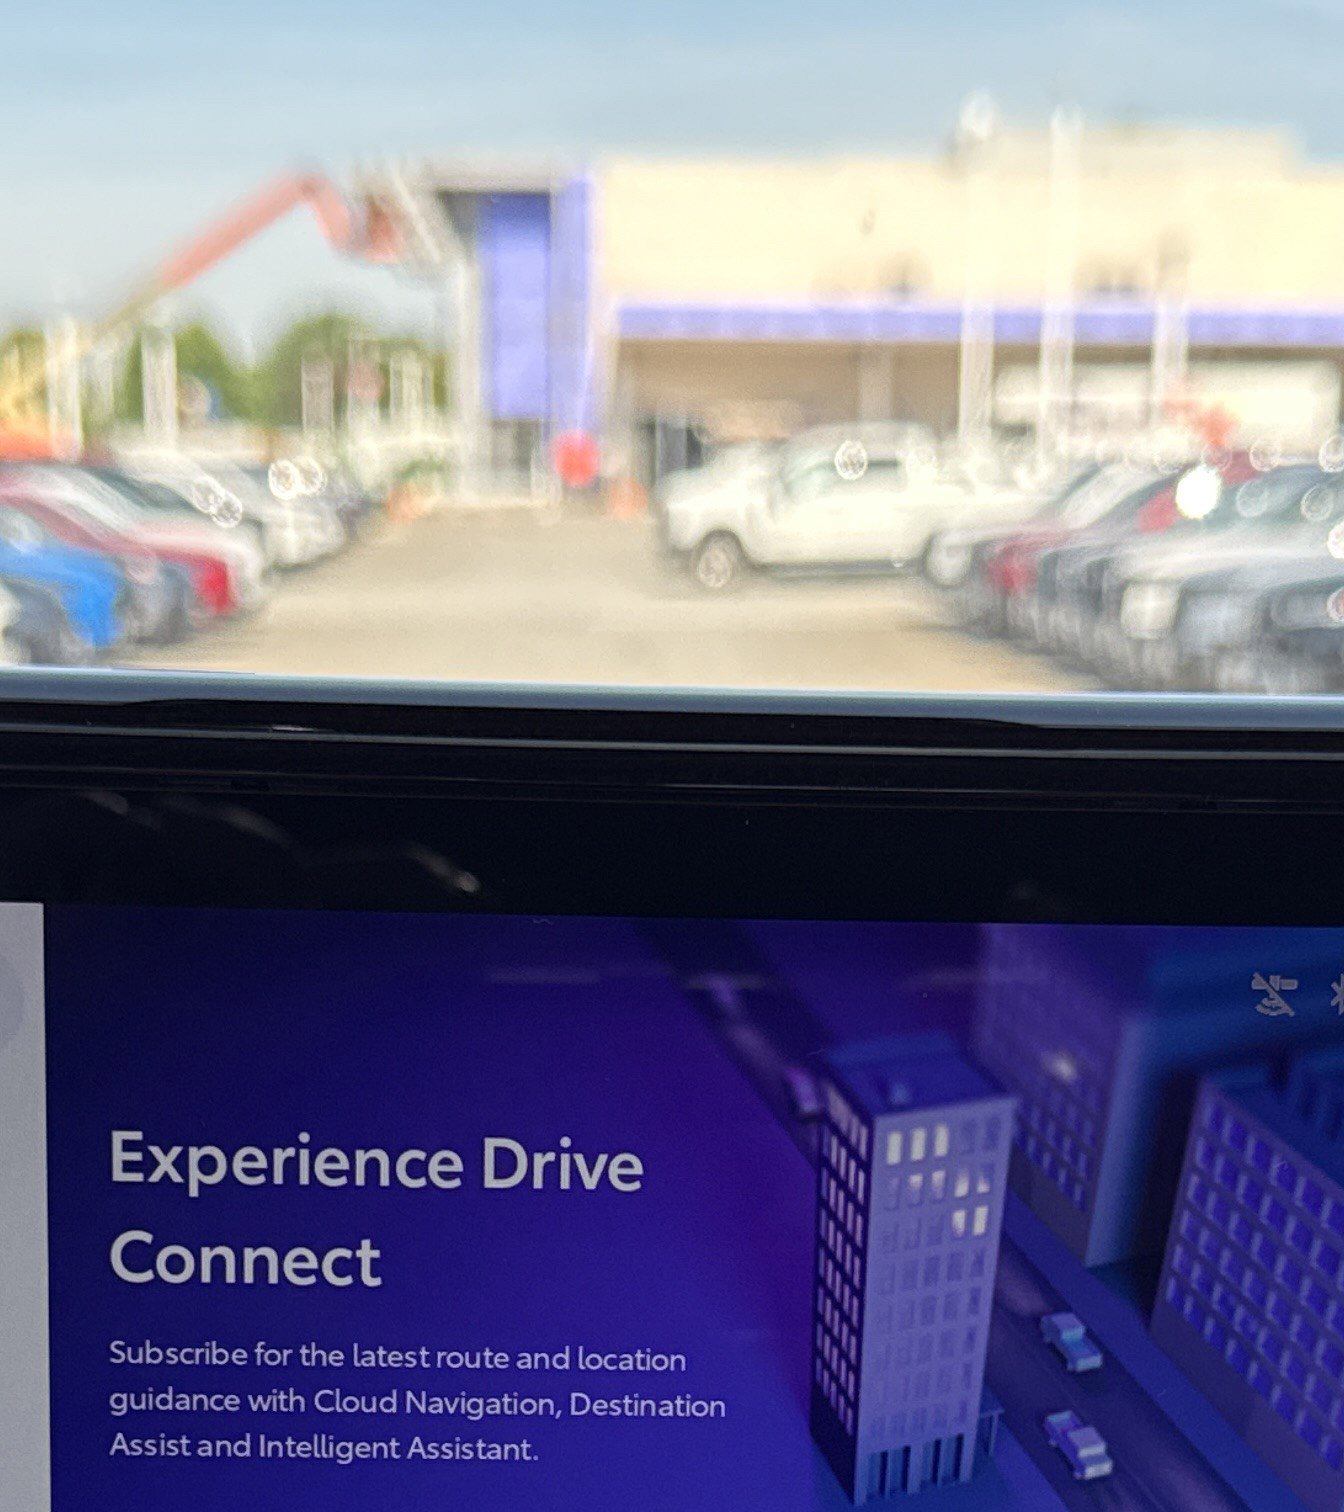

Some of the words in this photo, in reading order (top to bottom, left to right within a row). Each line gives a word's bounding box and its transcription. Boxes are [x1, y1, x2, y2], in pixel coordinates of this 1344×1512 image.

[111, 1130, 464, 1198] Experience
[483, 1136, 644, 1192] Drive
[110, 1229, 382, 1287] Connect
[109, 1339, 248, 1366] Subscribe
[254, 1341, 294, 1366] for
[299, 1341, 345, 1367] the
[353, 1342, 431, 1368] latest
[436, 1347, 510, 1369] route
[516, 1345, 570, 1370] and
[578, 1345, 686, 1372] location
[109, 1385, 241, 1417] guidance
[247, 1387, 306, 1412] with
[314, 1388, 397, 1414] Cloud
[405, 1390, 562, 1421] Navigation,
[570, 1392, 726, 1418] Destination
[109, 1432, 192, 1457] Assist
[196, 1432, 252, 1458] and
[259, 1433, 402, 1465] Intelligent
[406, 1436, 539, 1461] Assistant.
